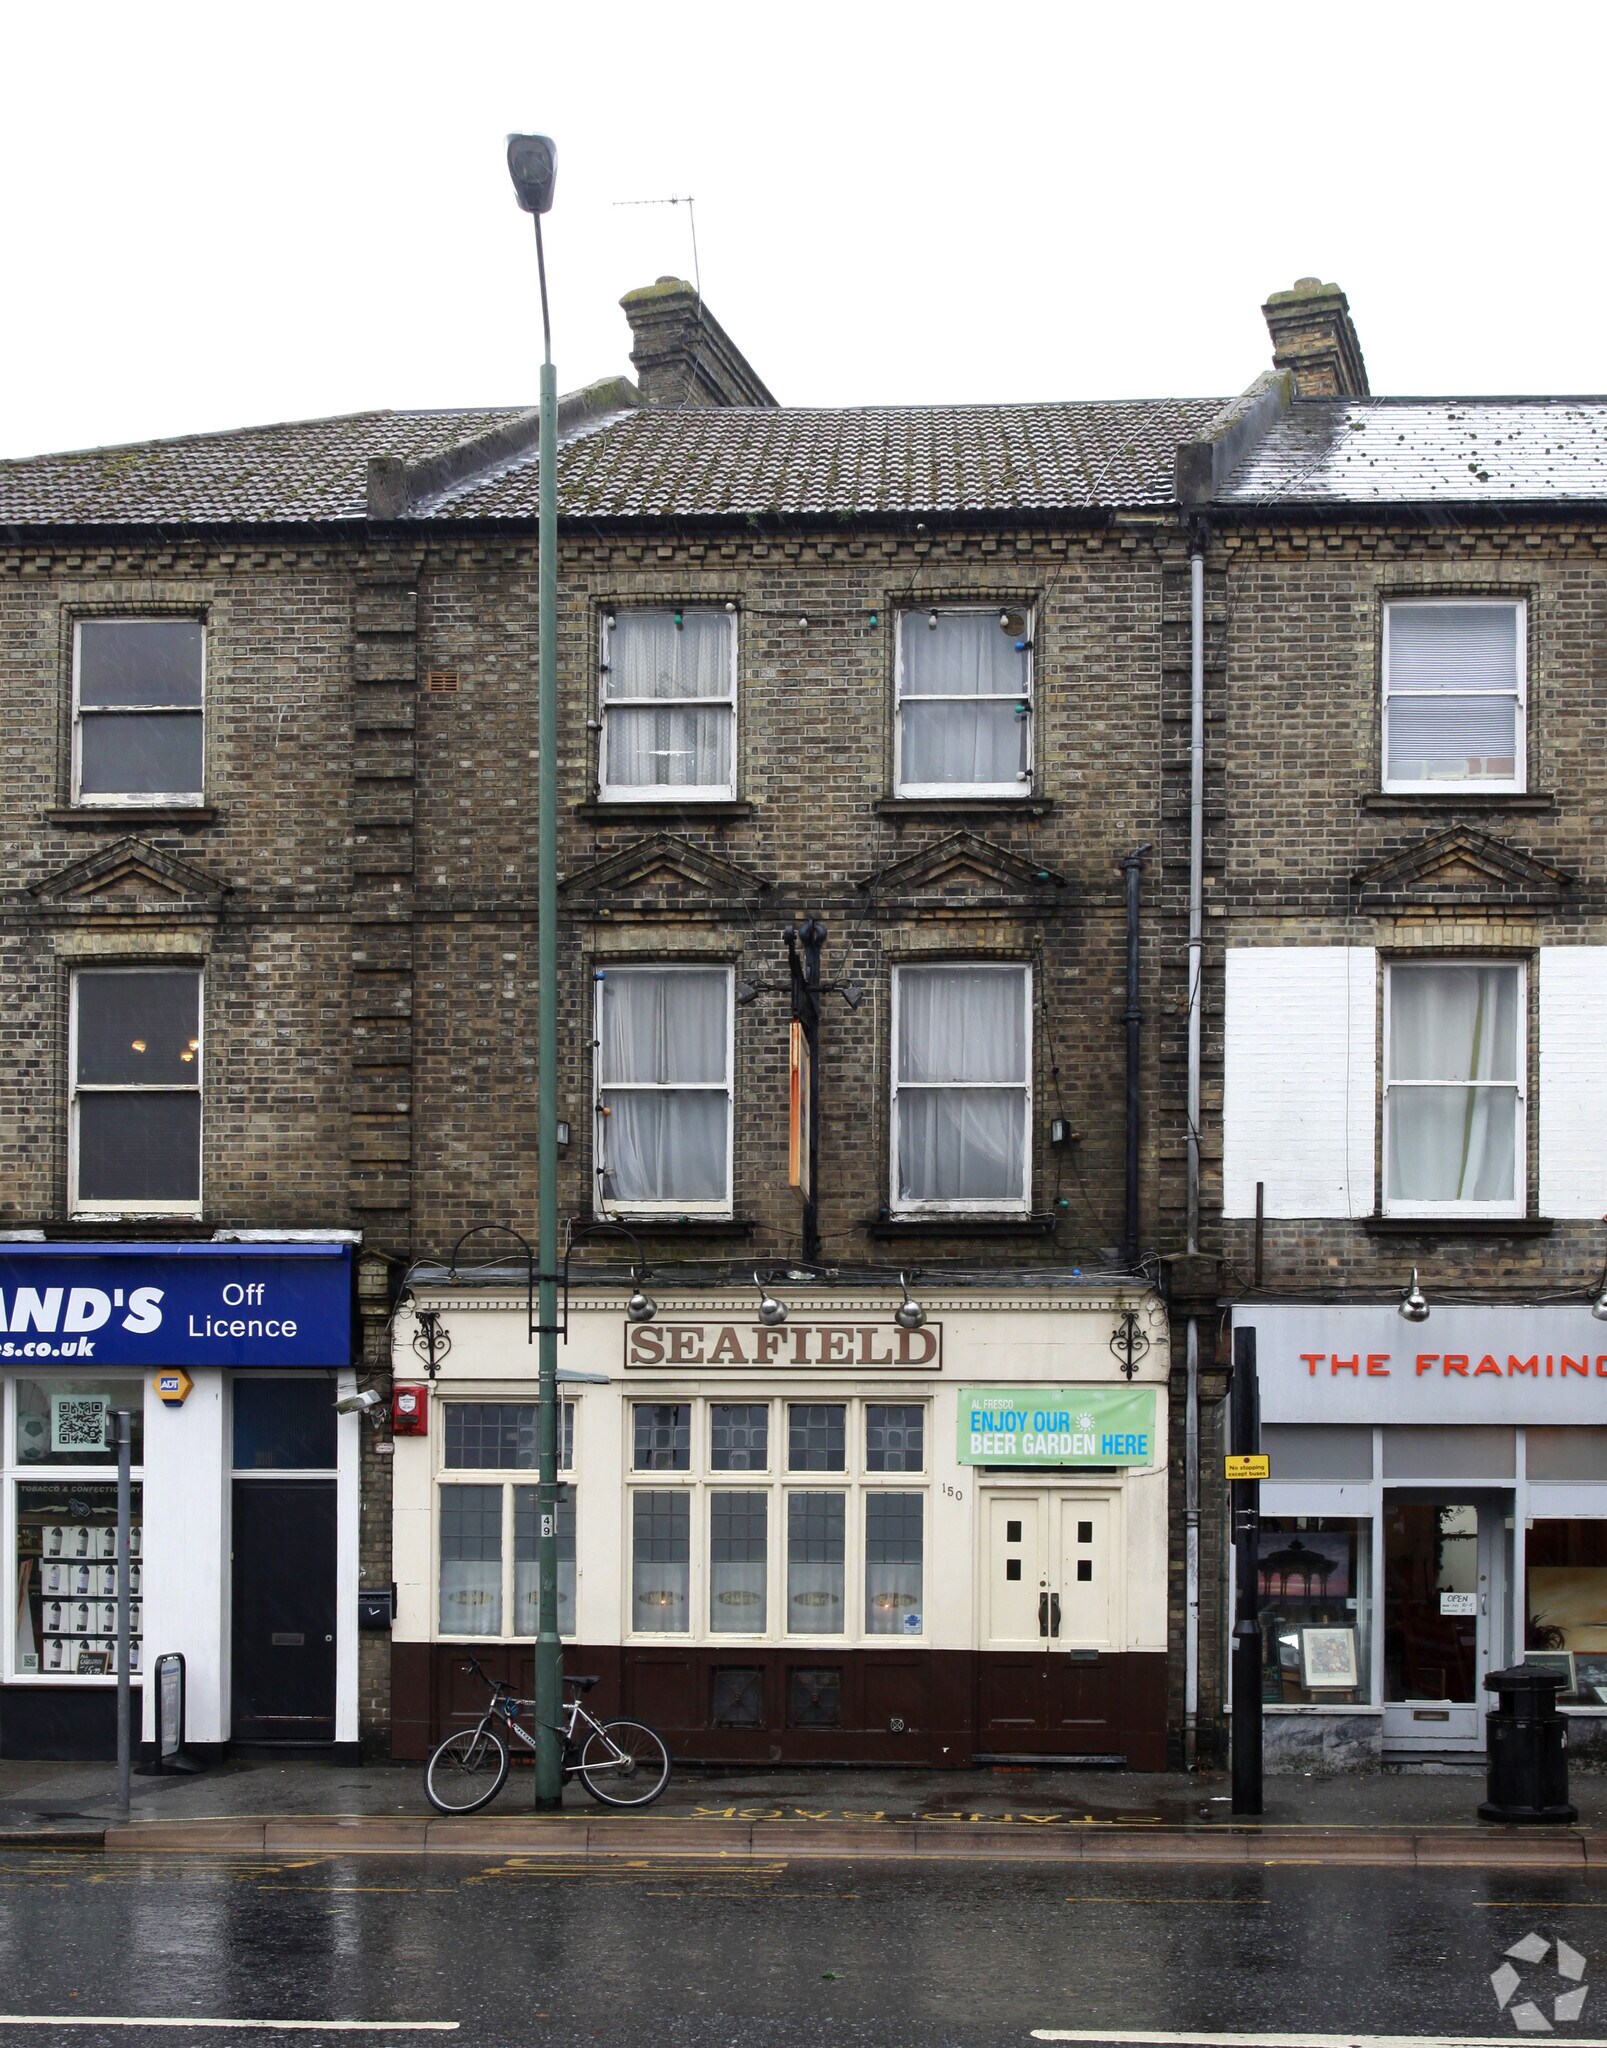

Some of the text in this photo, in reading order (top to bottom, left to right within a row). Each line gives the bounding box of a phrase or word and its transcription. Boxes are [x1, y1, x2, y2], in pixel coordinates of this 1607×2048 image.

[222, 1283, 266, 1306] Off
[0, 1286, 165, 1334] ND'S
[188, 1315, 298, 1337] Licence
[0, 1336, 96, 1358] s.co.uk
[630, 1325, 937, 1365] SEAFIELD
[1300, 1354, 1391, 1376] THE
[160, 1378, 179, 1390] ADT
[971, 1399, 1014, 1409] AL FRESCO
[970, 1411, 1070, 1433] ENJOY OUR
[970, 1433, 1148, 1456] BEER GARDEN HERE
[20, 1485, 142, 1493] TOBACCO & CONFECTIORY
[942, 1483, 963, 1501] 150
